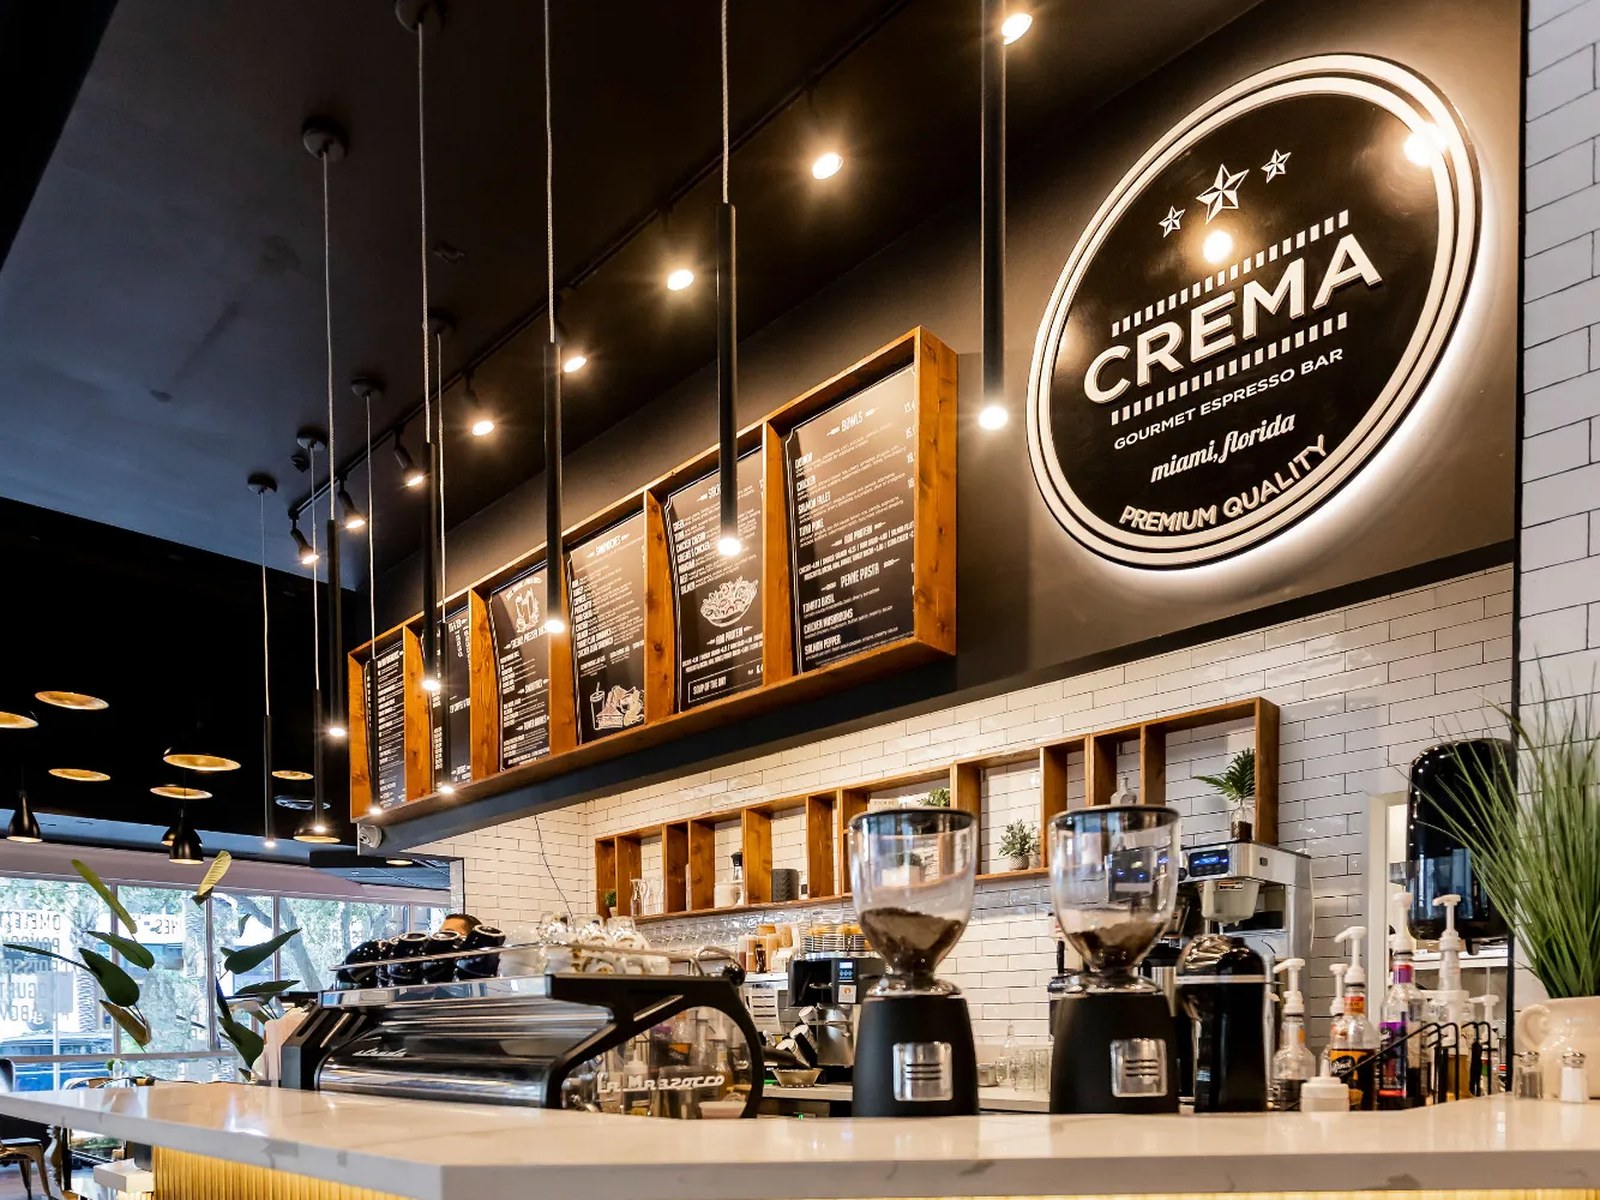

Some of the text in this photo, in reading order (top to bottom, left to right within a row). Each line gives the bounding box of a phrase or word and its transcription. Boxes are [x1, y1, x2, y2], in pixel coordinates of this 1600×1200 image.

[1083, 233, 1383, 404] CREMA
[1114, 347, 1344, 450] GOURMET ESPRESSO BAR
[1118, 433, 1328, 533] PREMIUM QUALITY
[859, 562, 880, 581] PASTA
